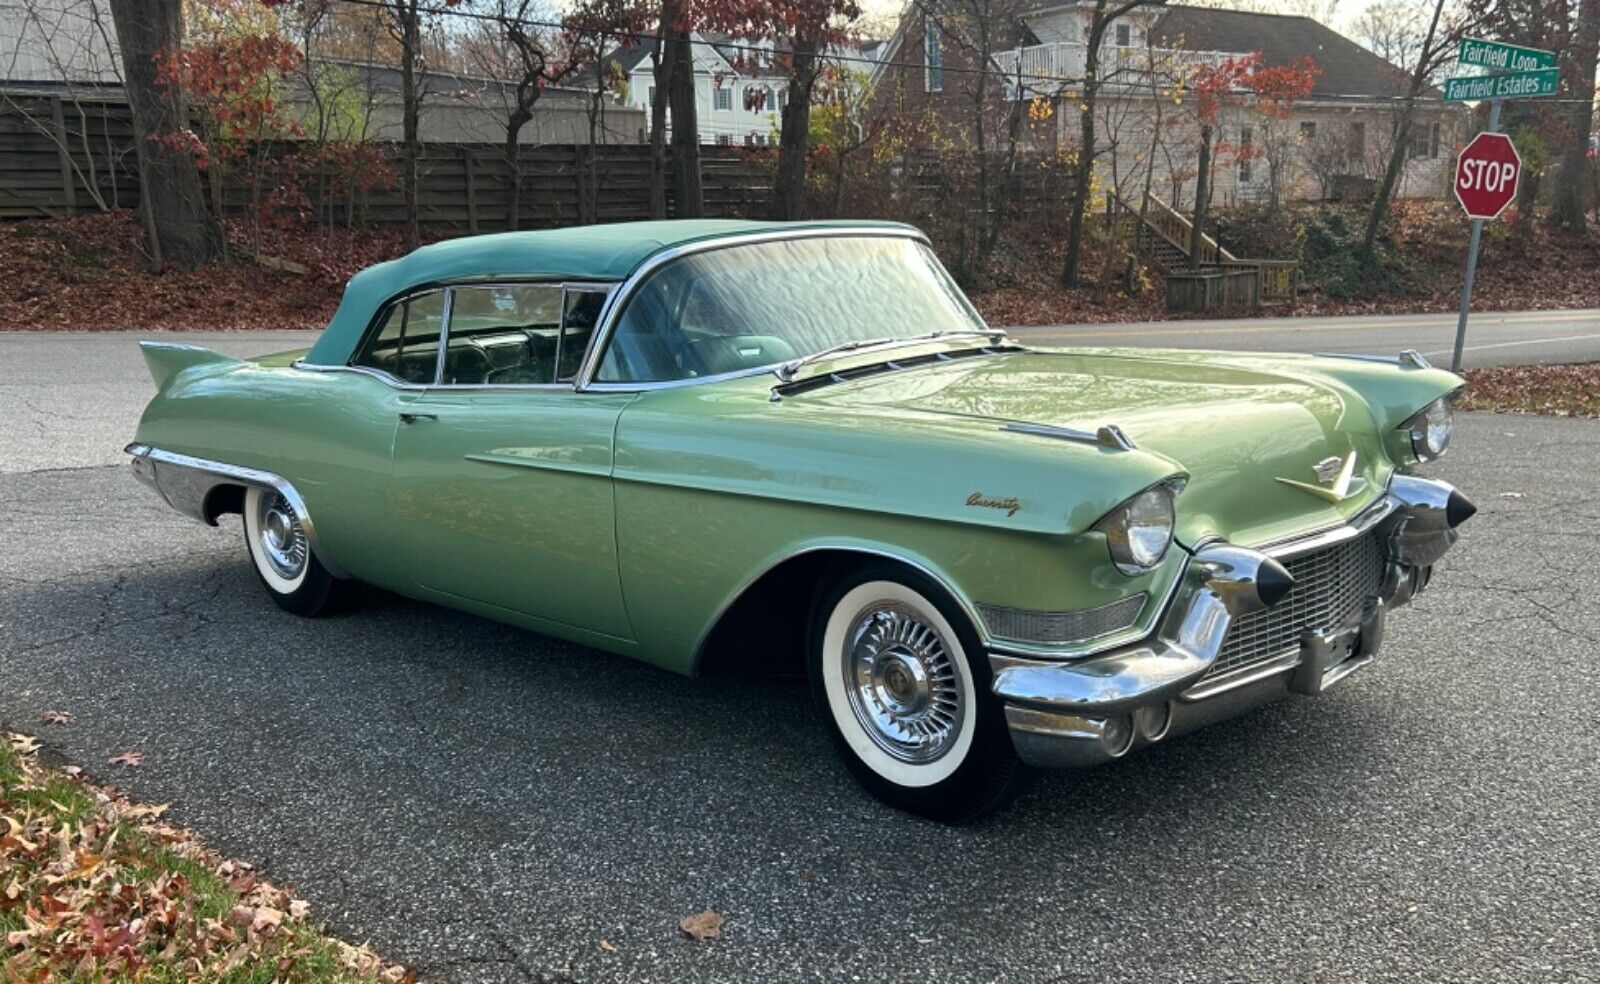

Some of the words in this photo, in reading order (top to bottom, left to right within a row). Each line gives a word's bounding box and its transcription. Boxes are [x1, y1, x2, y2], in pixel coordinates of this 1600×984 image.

[1462, 41, 1508, 67] Fairfield
[1448, 78, 1494, 99] Fairfield
[1496, 74, 1539, 95] Estates
[1460, 158, 1515, 193] STOP
